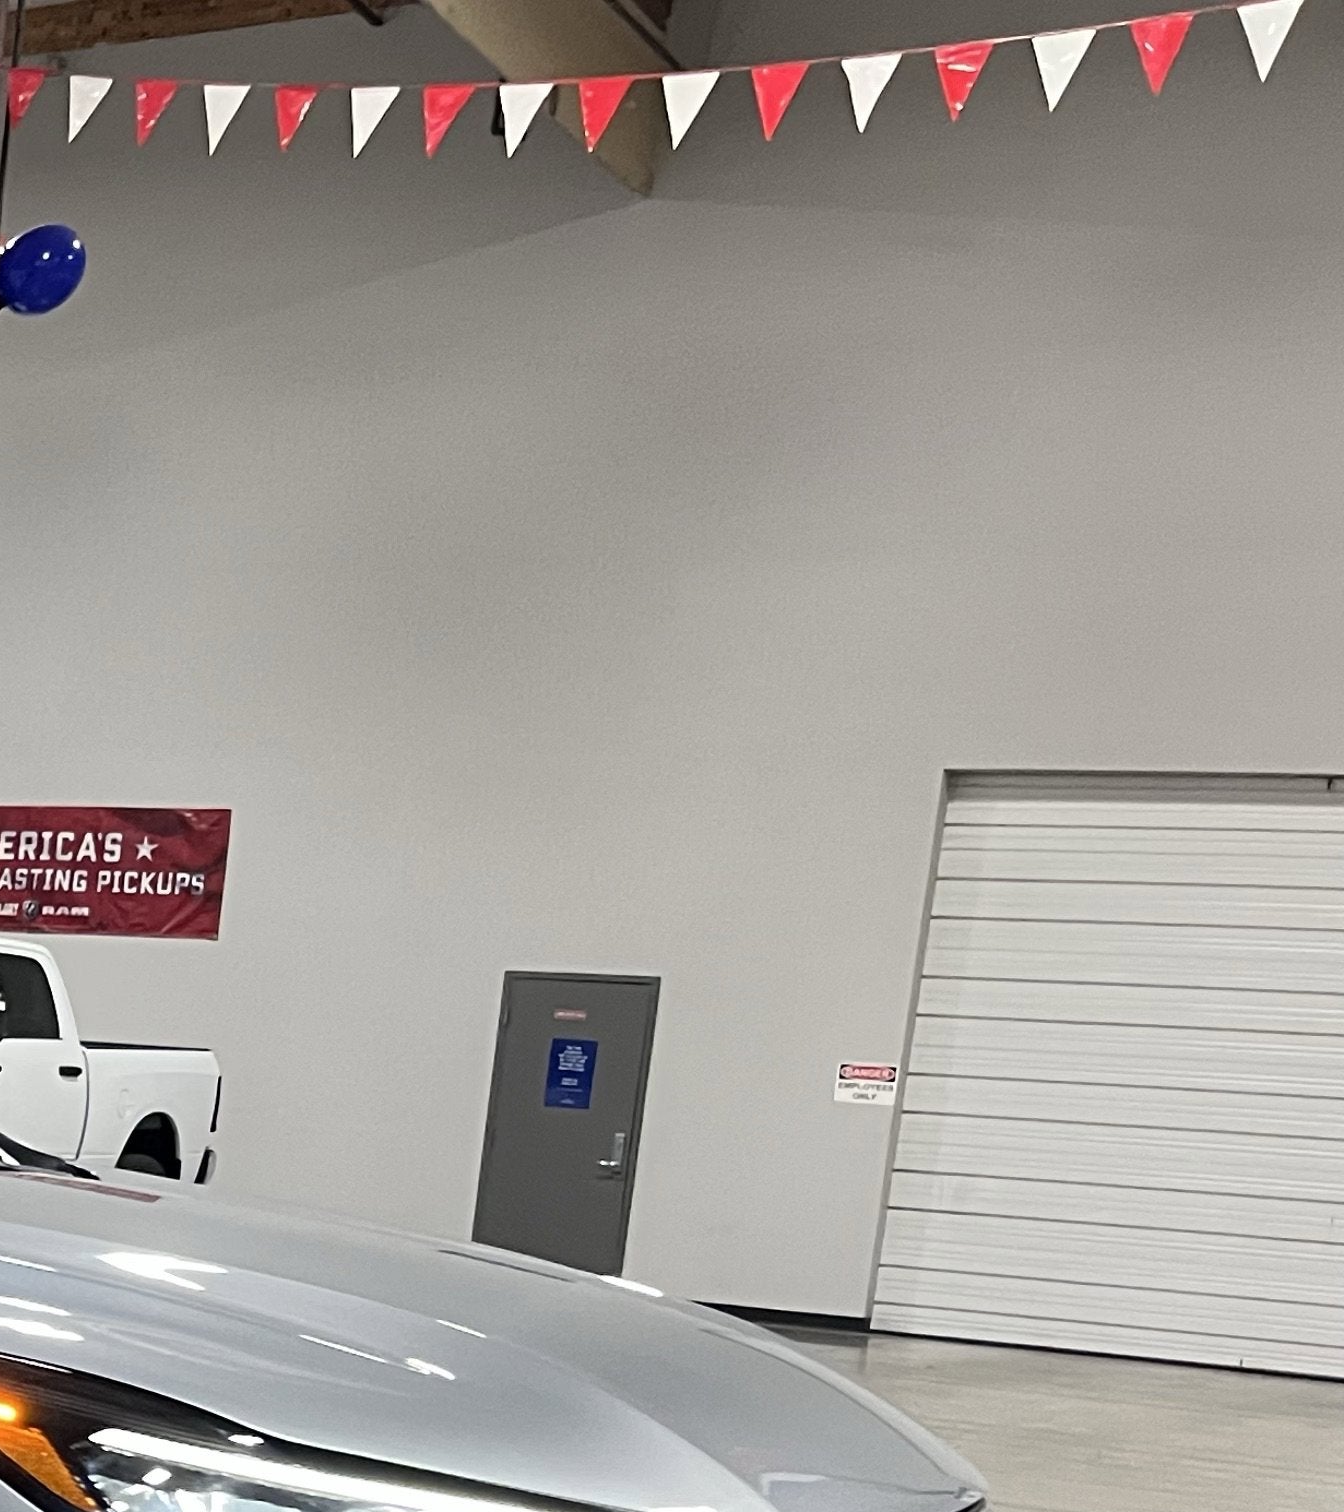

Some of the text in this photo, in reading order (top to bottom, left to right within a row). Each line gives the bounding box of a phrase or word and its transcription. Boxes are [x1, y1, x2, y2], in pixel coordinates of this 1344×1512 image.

[96, 870, 205, 895] PICKUPS
[838, 1082, 894, 1092] EMPLOYEES
[852, 1092, 877, 1100] ONLY
